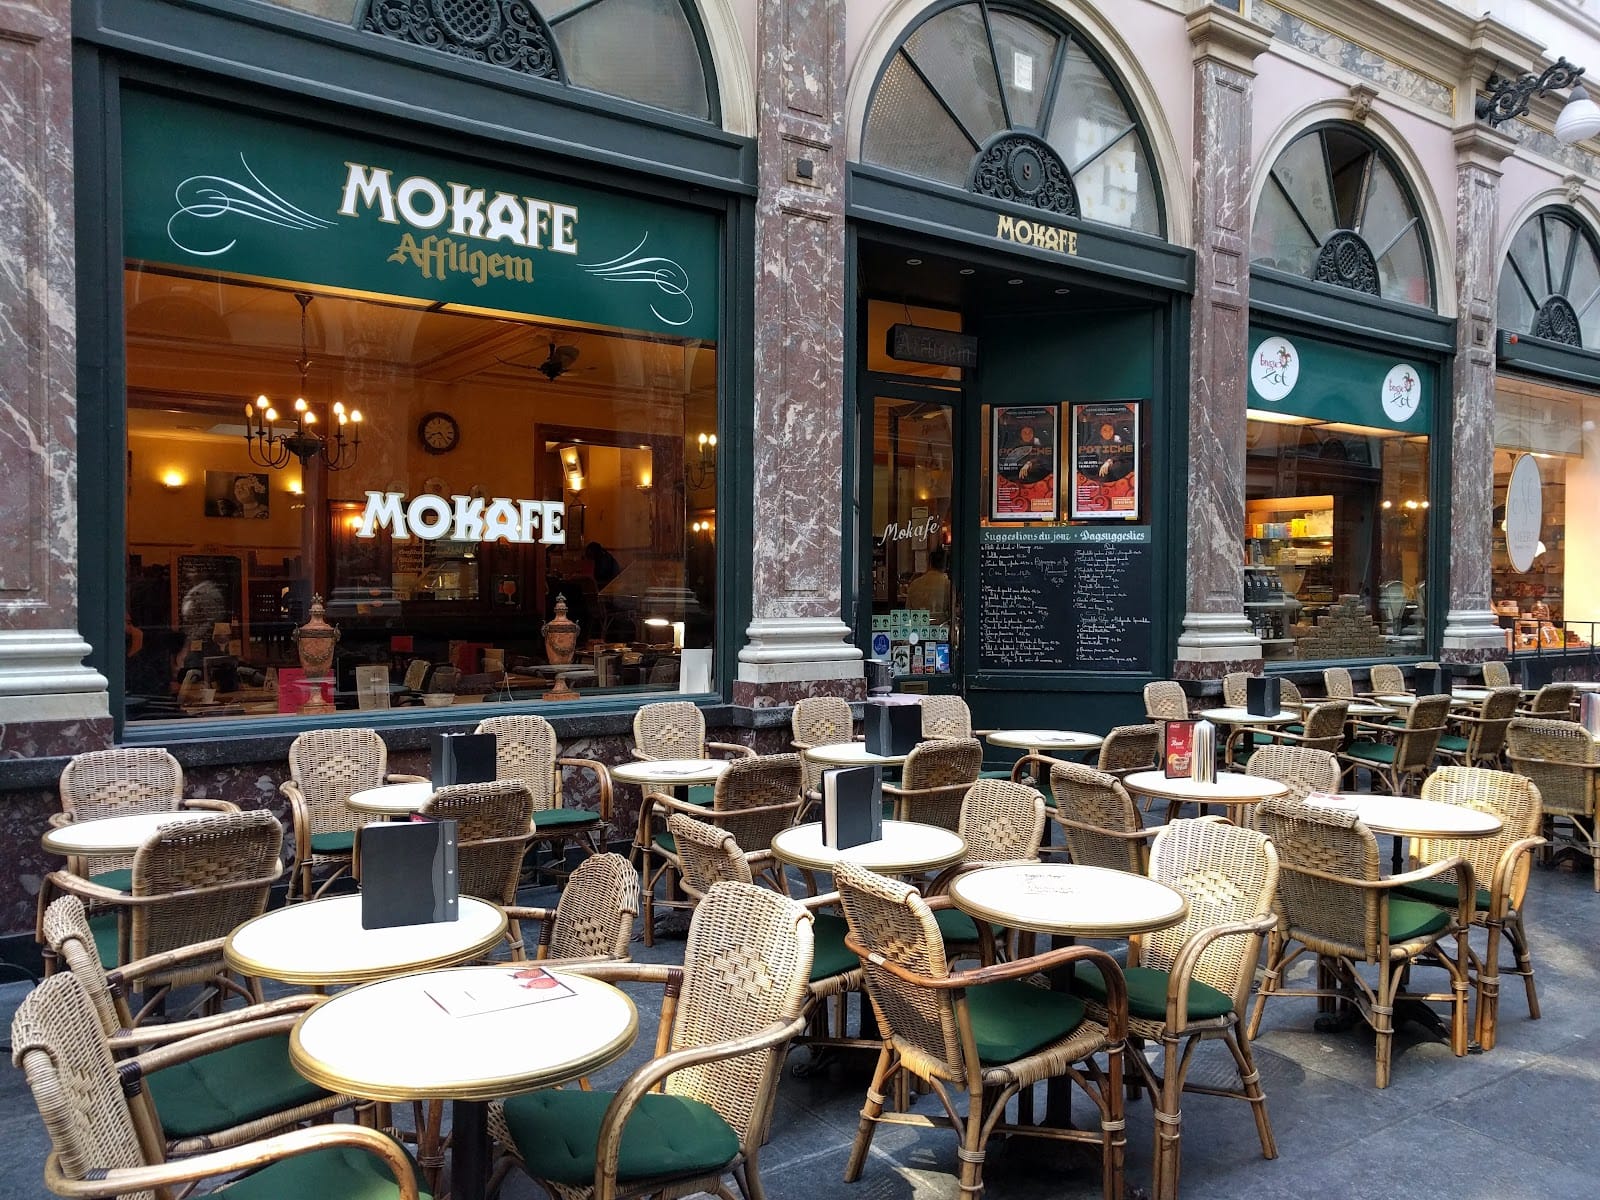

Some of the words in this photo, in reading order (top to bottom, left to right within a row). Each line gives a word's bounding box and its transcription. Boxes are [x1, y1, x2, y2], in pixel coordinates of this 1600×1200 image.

[338, 161, 579, 256] MOKAFE
[997, 215, 1078, 255] MOKAFE
[387, 232, 534, 286] Affligem
[356, 491, 566, 545] MOKAFE
[984, 531, 1037, 543] Suggestions
[1039, 532, 1050, 541] du
[1080, 529, 1145, 543] Dagsuggesties
